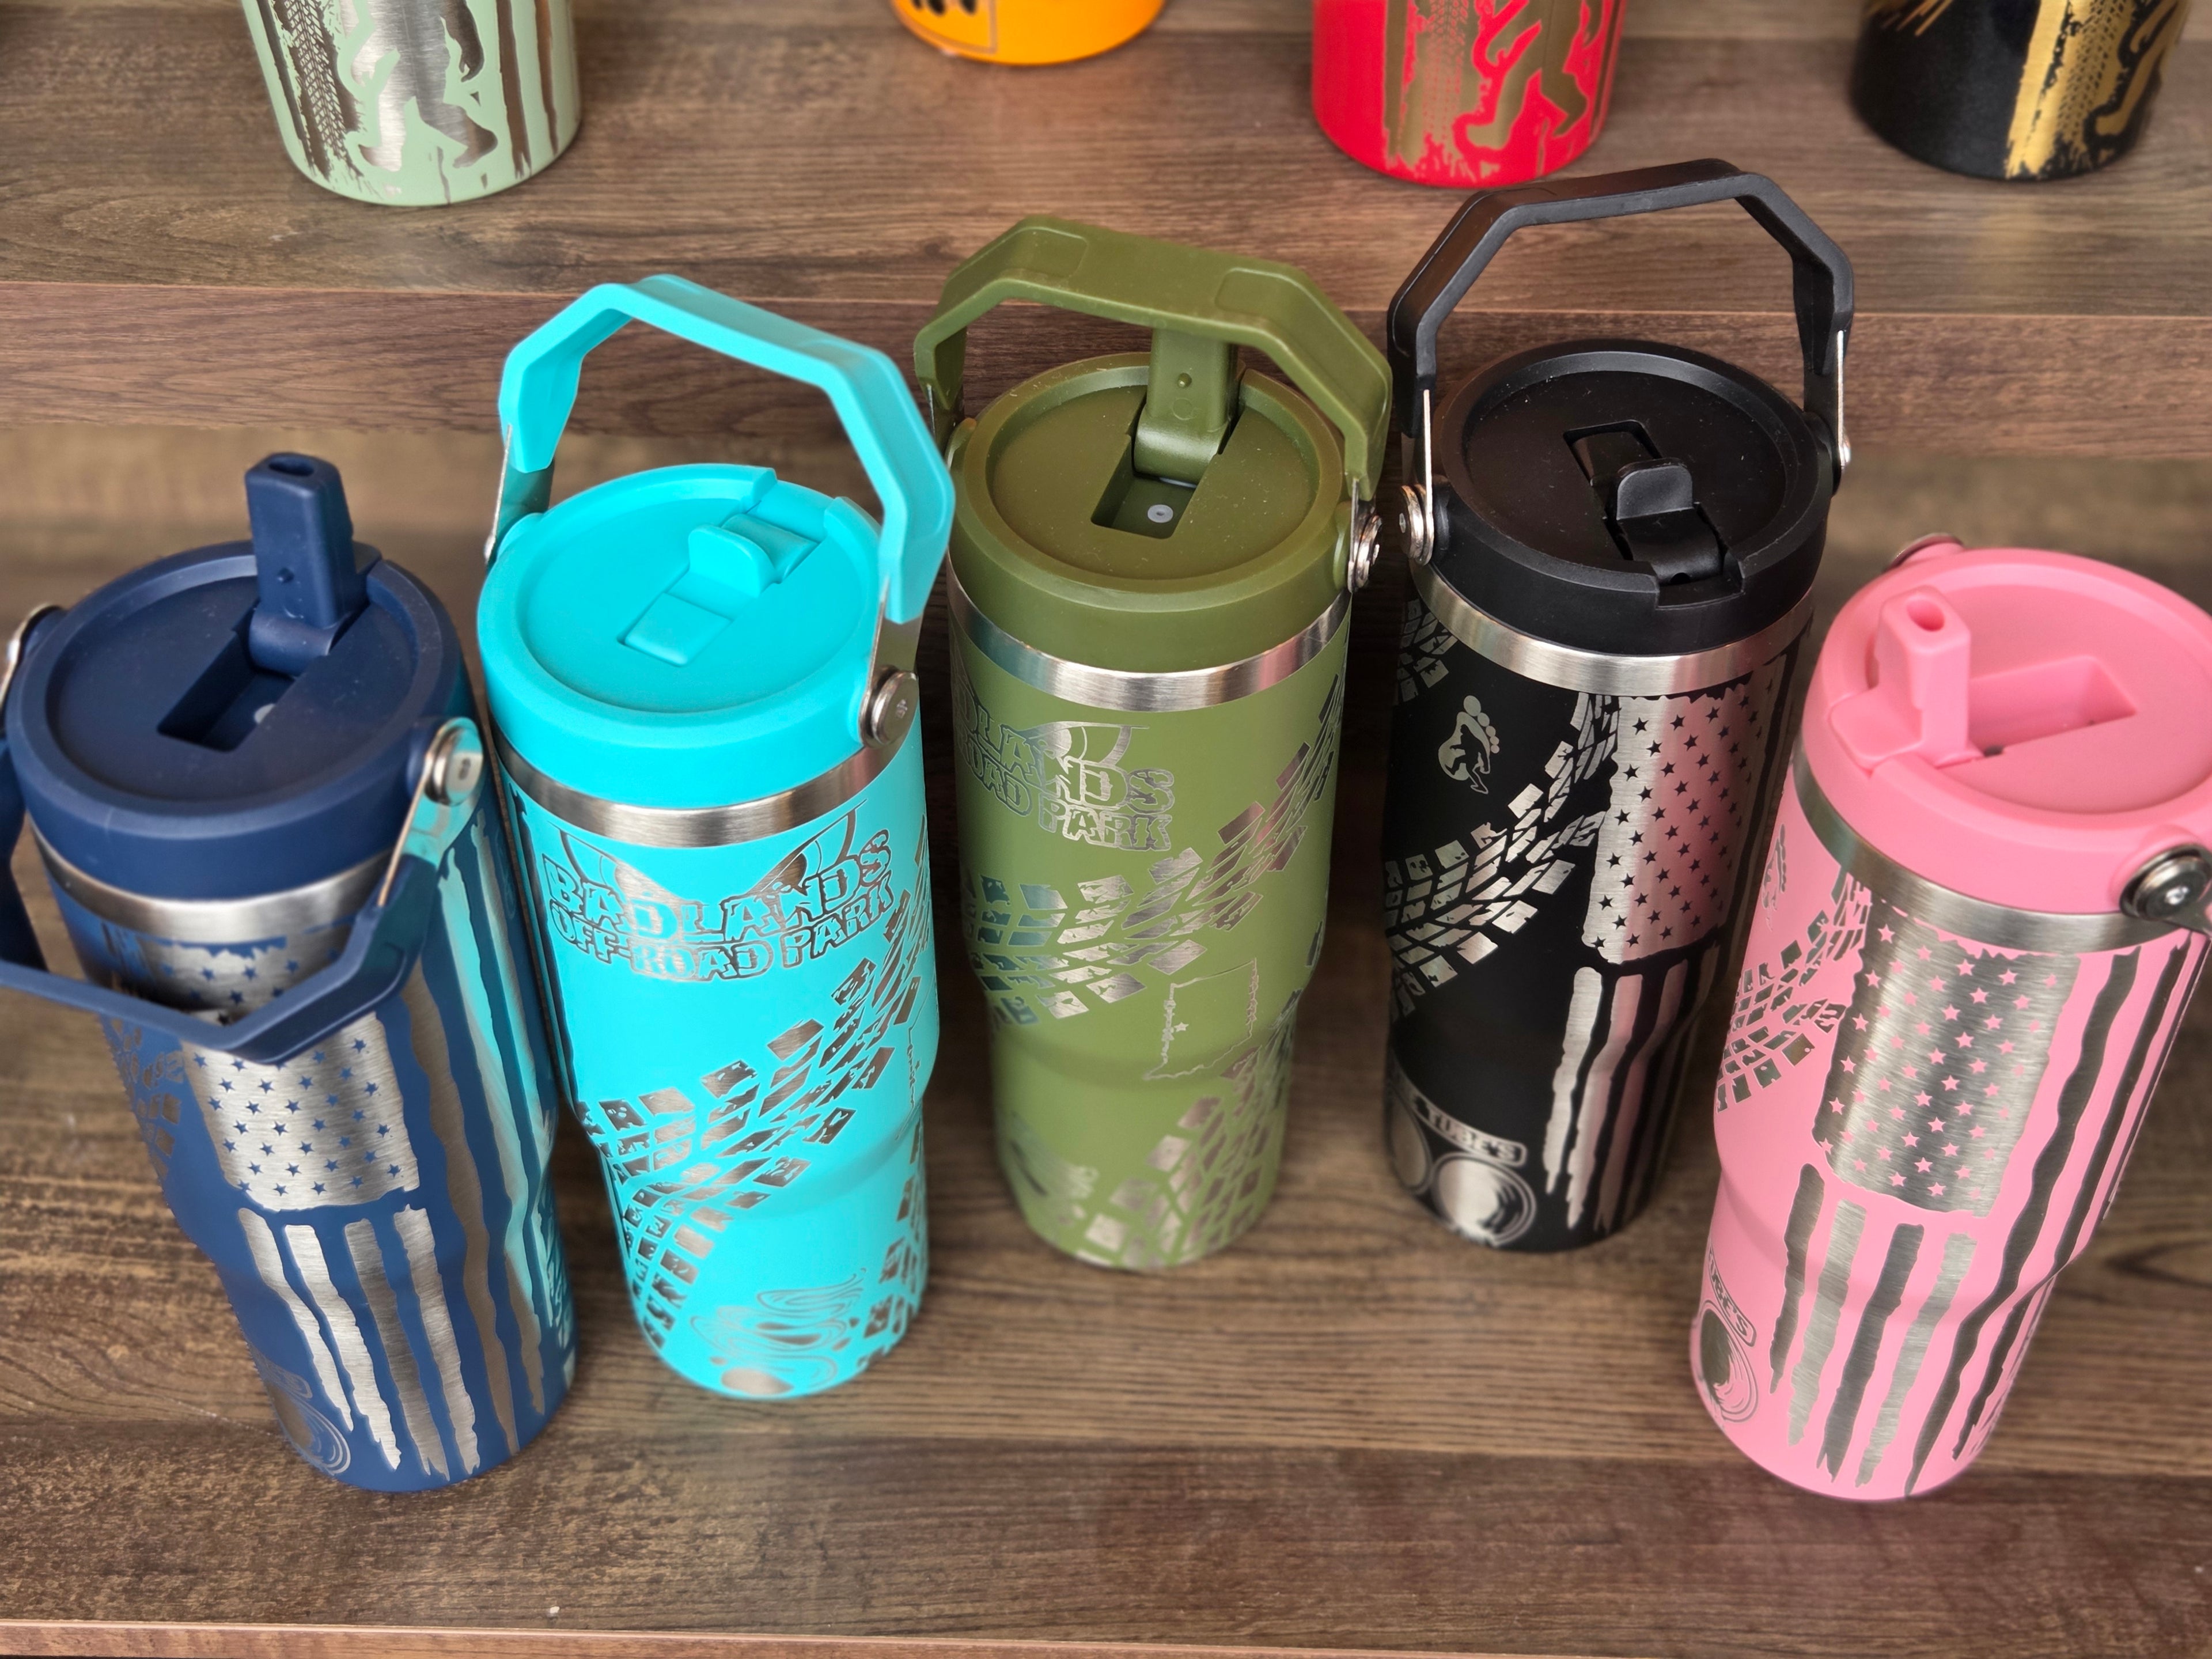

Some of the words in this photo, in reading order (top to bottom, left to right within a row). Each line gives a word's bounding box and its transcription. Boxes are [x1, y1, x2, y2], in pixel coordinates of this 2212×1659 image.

[955, 675, 1175, 814] DLANDS
[1038, 793, 1172, 852] PARK
[543, 830, 892, 940] BADLANDS
[550, 899, 772, 982] OFF-ROAD
[781, 870, 893, 968] PARK
